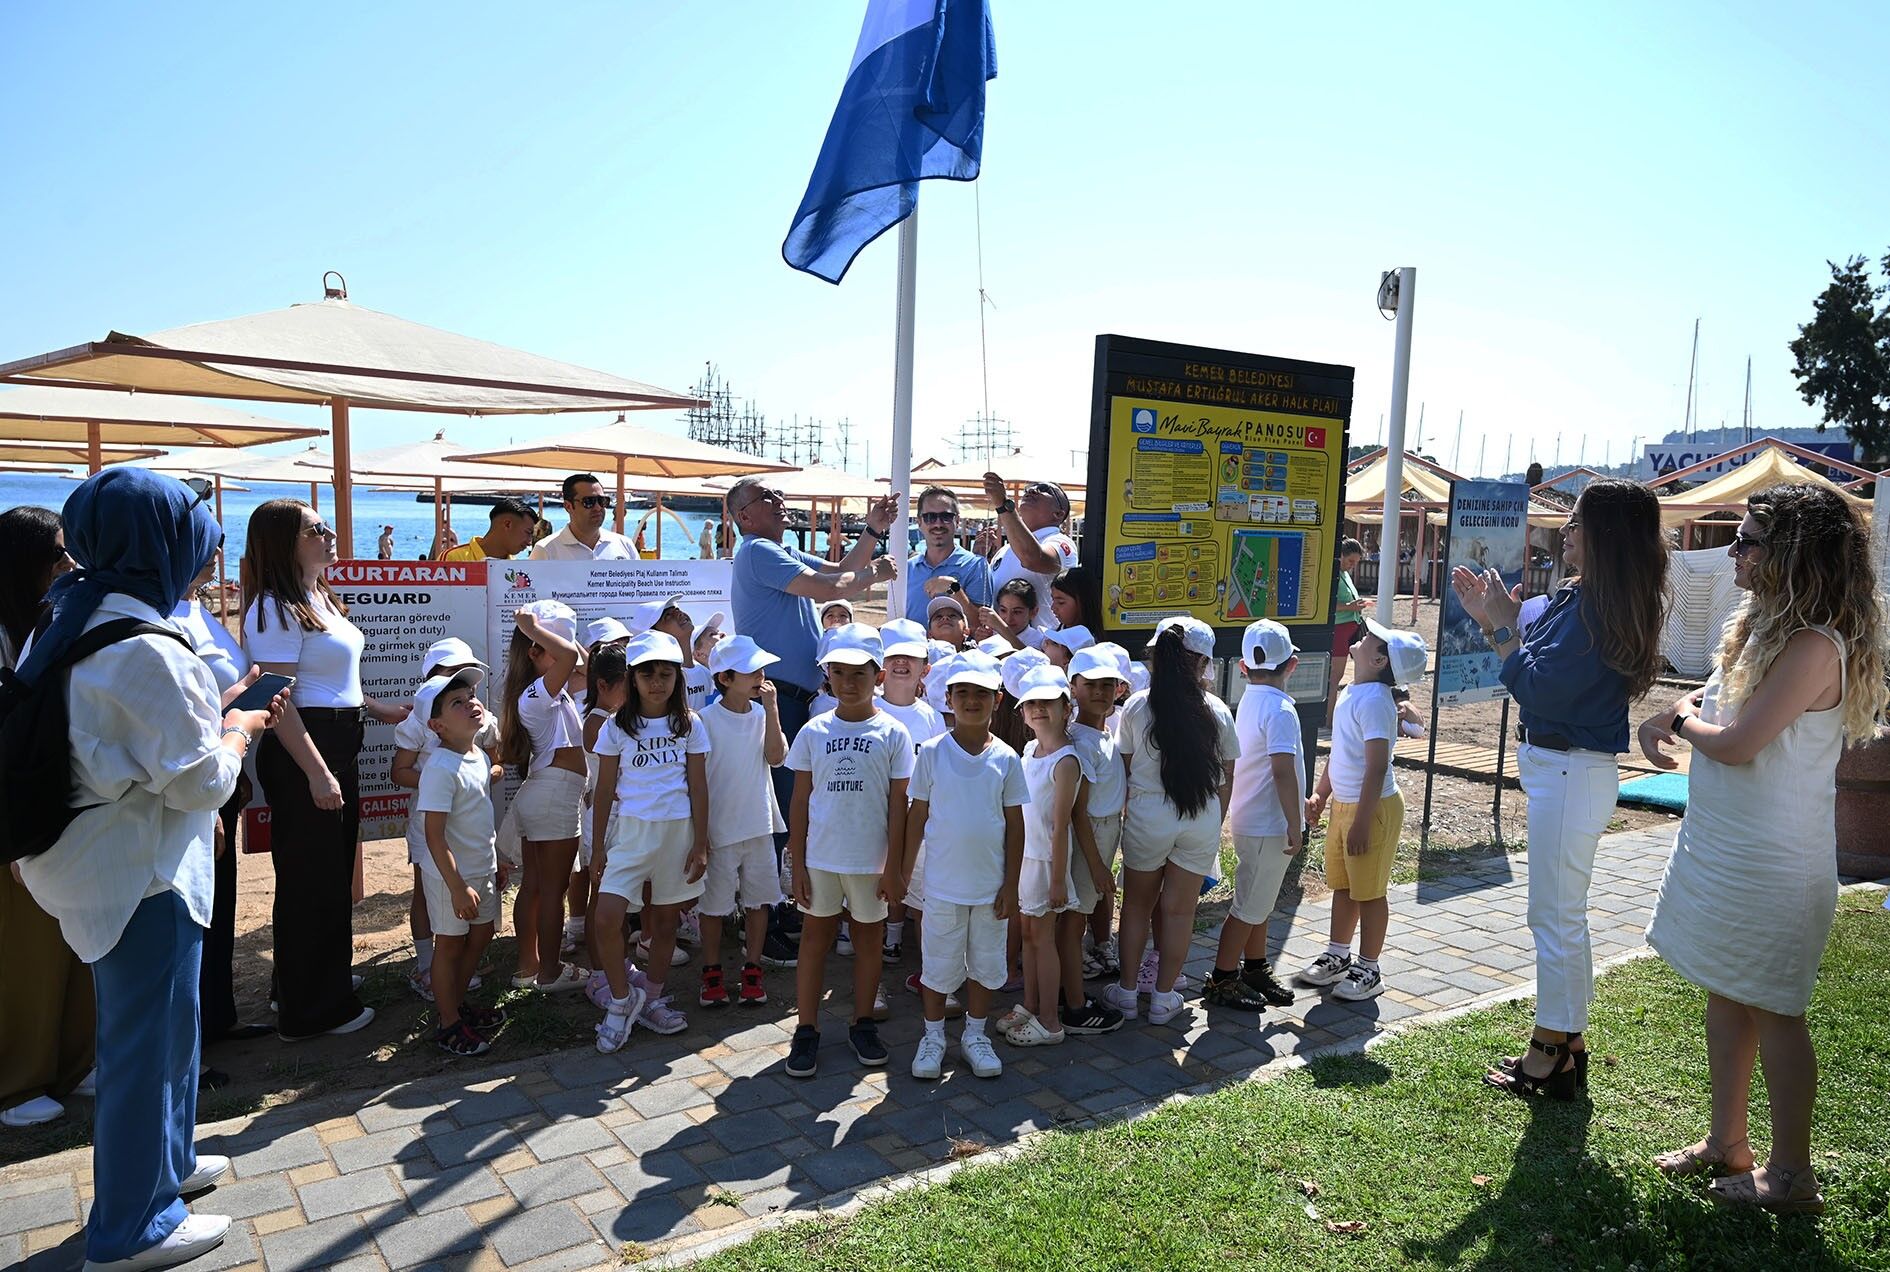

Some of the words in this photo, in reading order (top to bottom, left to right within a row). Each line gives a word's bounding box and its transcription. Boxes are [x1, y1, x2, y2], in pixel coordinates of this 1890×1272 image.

[1184, 363, 1225, 380] KEMER
[1126, 376, 1182, 397] MUSTAFA
[1250, 392, 1279, 408] AKER
[1282, 395, 1309, 410] HALK
[1159, 415, 1197, 435] Mavi
[1195, 418, 1242, 443] Bayrak
[1245, 421, 1304, 439] PANOSU
[1500, 516, 1520, 528] KORU
[327, 566, 466, 582] KURTARAN
[590, 570, 608, 578] Kemer
[608, 570, 635, 579] Belediyesi
[635, 570, 646, 579] Plaj
[605, 580, 636, 589] Municipality
[348, 613, 406, 623] ankurtaran
[409, 612, 451, 624] görevde
[403, 627, 416, 635] on
[419, 625, 446, 637] duty)
[379, 641, 415, 652] girmek
[360, 653, 408, 664] wimming
[410, 653, 420, 662] is
[361, 677, 406, 687] kurtaran
[360, 743, 400, 753] kurtara
[636, 736, 677, 752] KIDS
[826, 737, 850, 755] DEEP
[852, 737, 873, 754] SEE
[379, 755, 388, 764] is
[360, 781, 401, 792] imming
[827, 780, 864, 792] ADVENTURE
[362, 798, 409, 816] ÇALIŞM
